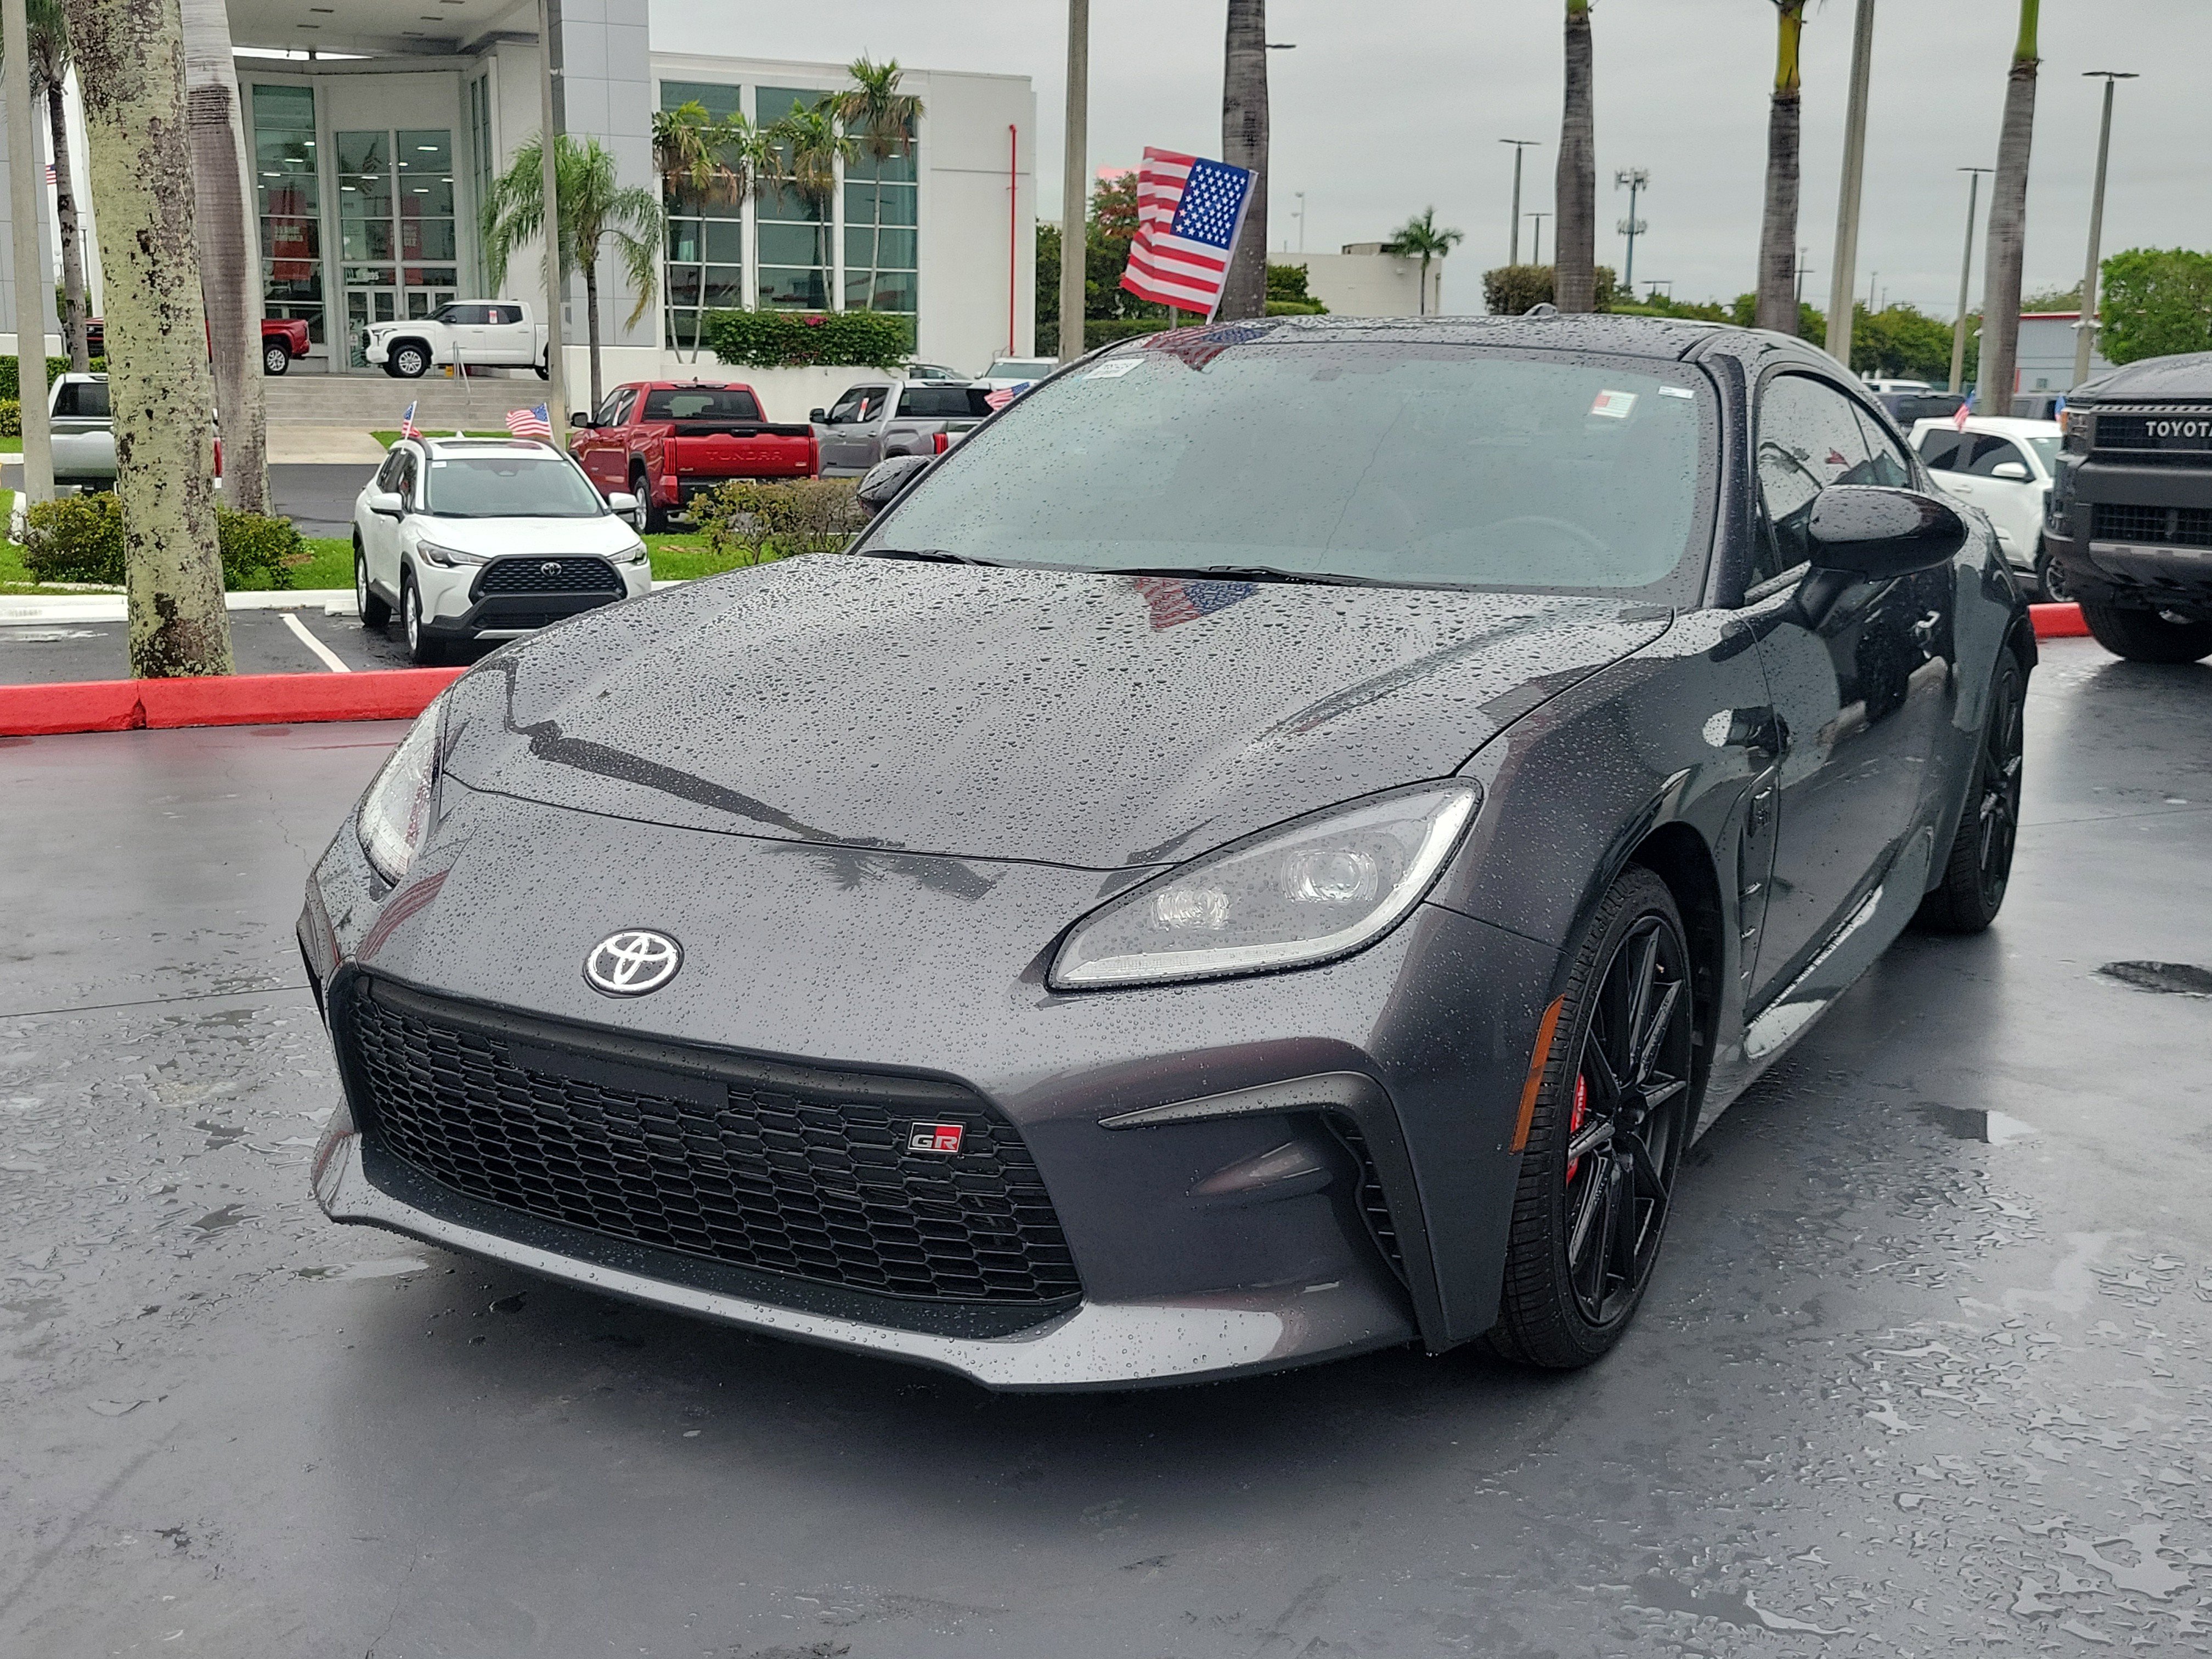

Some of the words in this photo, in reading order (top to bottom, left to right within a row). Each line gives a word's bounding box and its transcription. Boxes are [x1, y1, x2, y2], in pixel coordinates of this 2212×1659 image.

[706, 450, 783, 460] TUNDRA
[1575, 1074, 1585, 1129] rembo
[912, 1134, 958, 1149] GR
